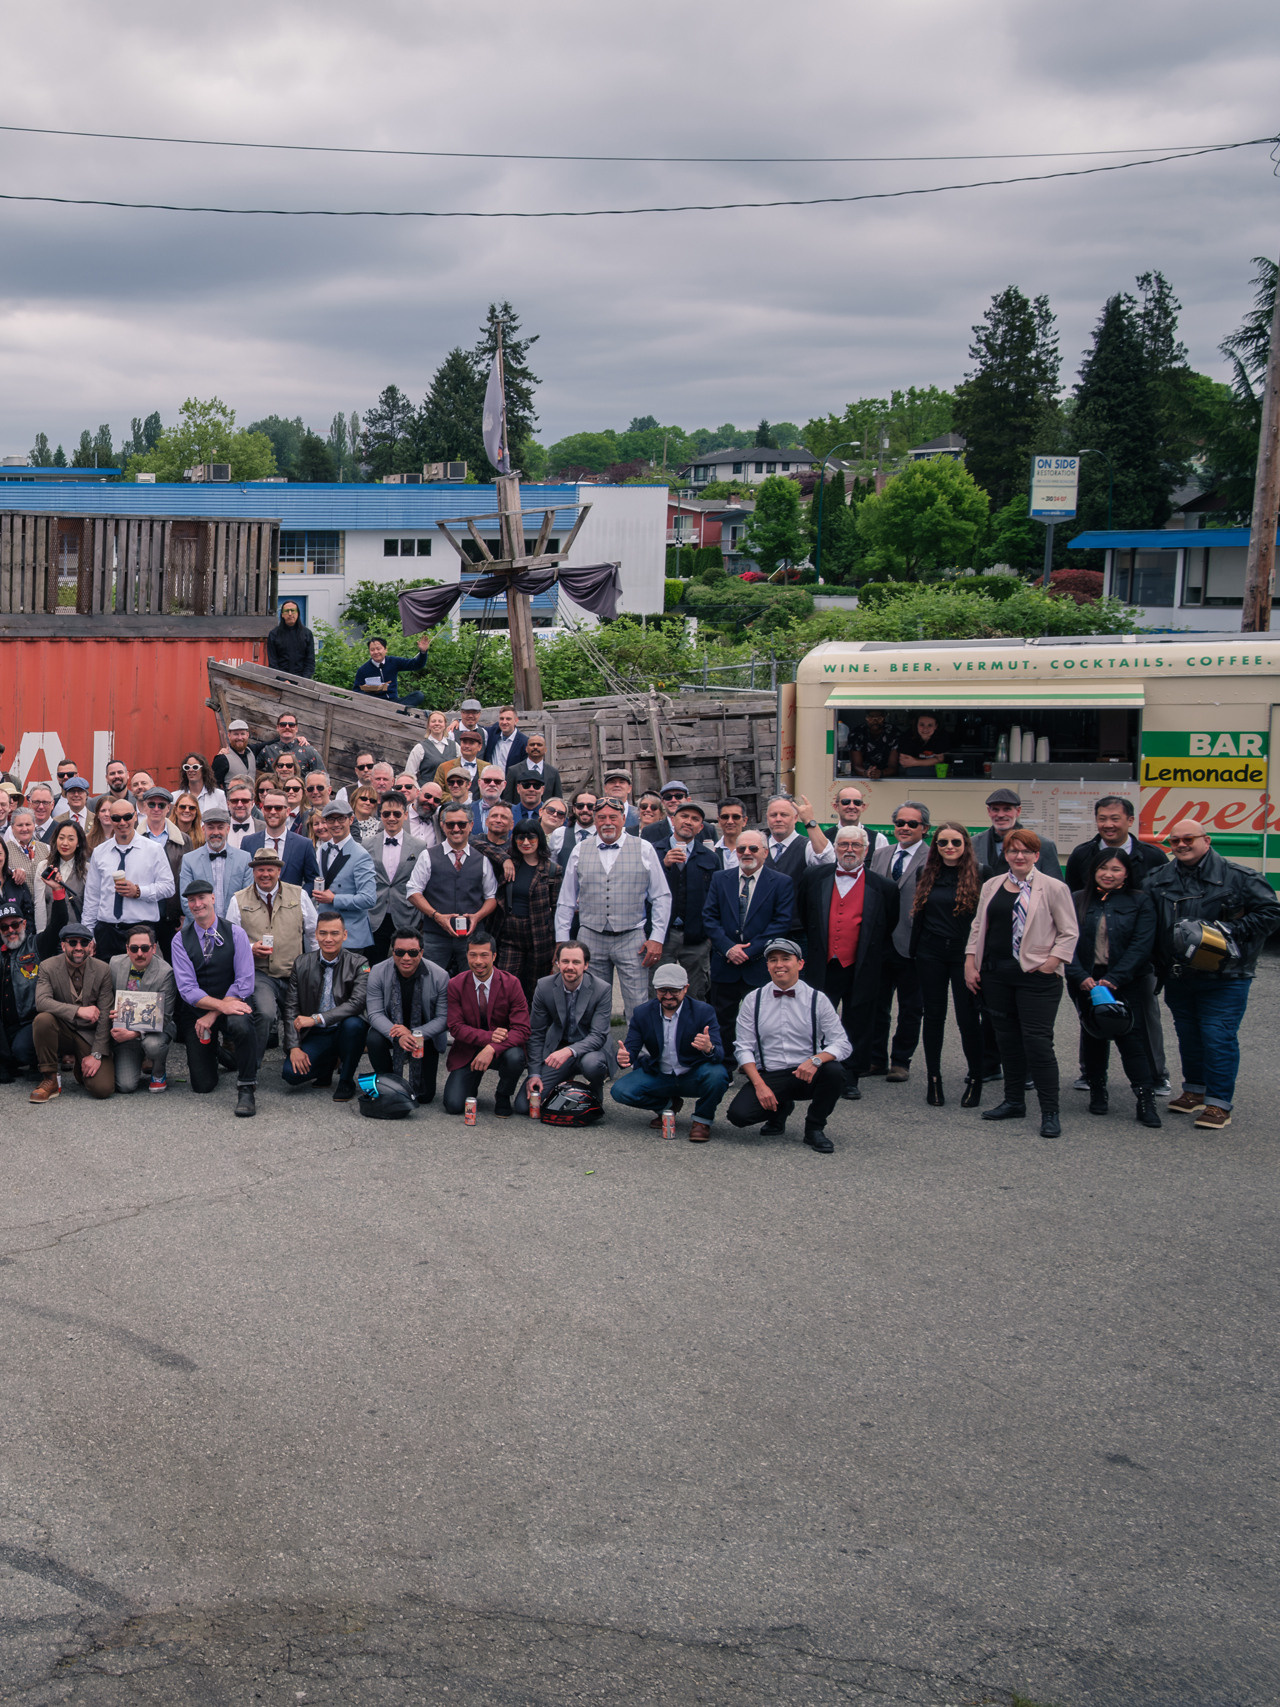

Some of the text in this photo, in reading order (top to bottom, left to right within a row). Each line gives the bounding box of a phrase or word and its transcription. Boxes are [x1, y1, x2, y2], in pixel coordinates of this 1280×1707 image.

[1037, 459, 1051, 469] ON
[823, 656, 1272, 674] WINE. BEER. VERMUT. COCKTAILS. COFFEE.
[1189, 733, 1263, 756] BAR
[1144, 762, 1264, 783] Lemonade
